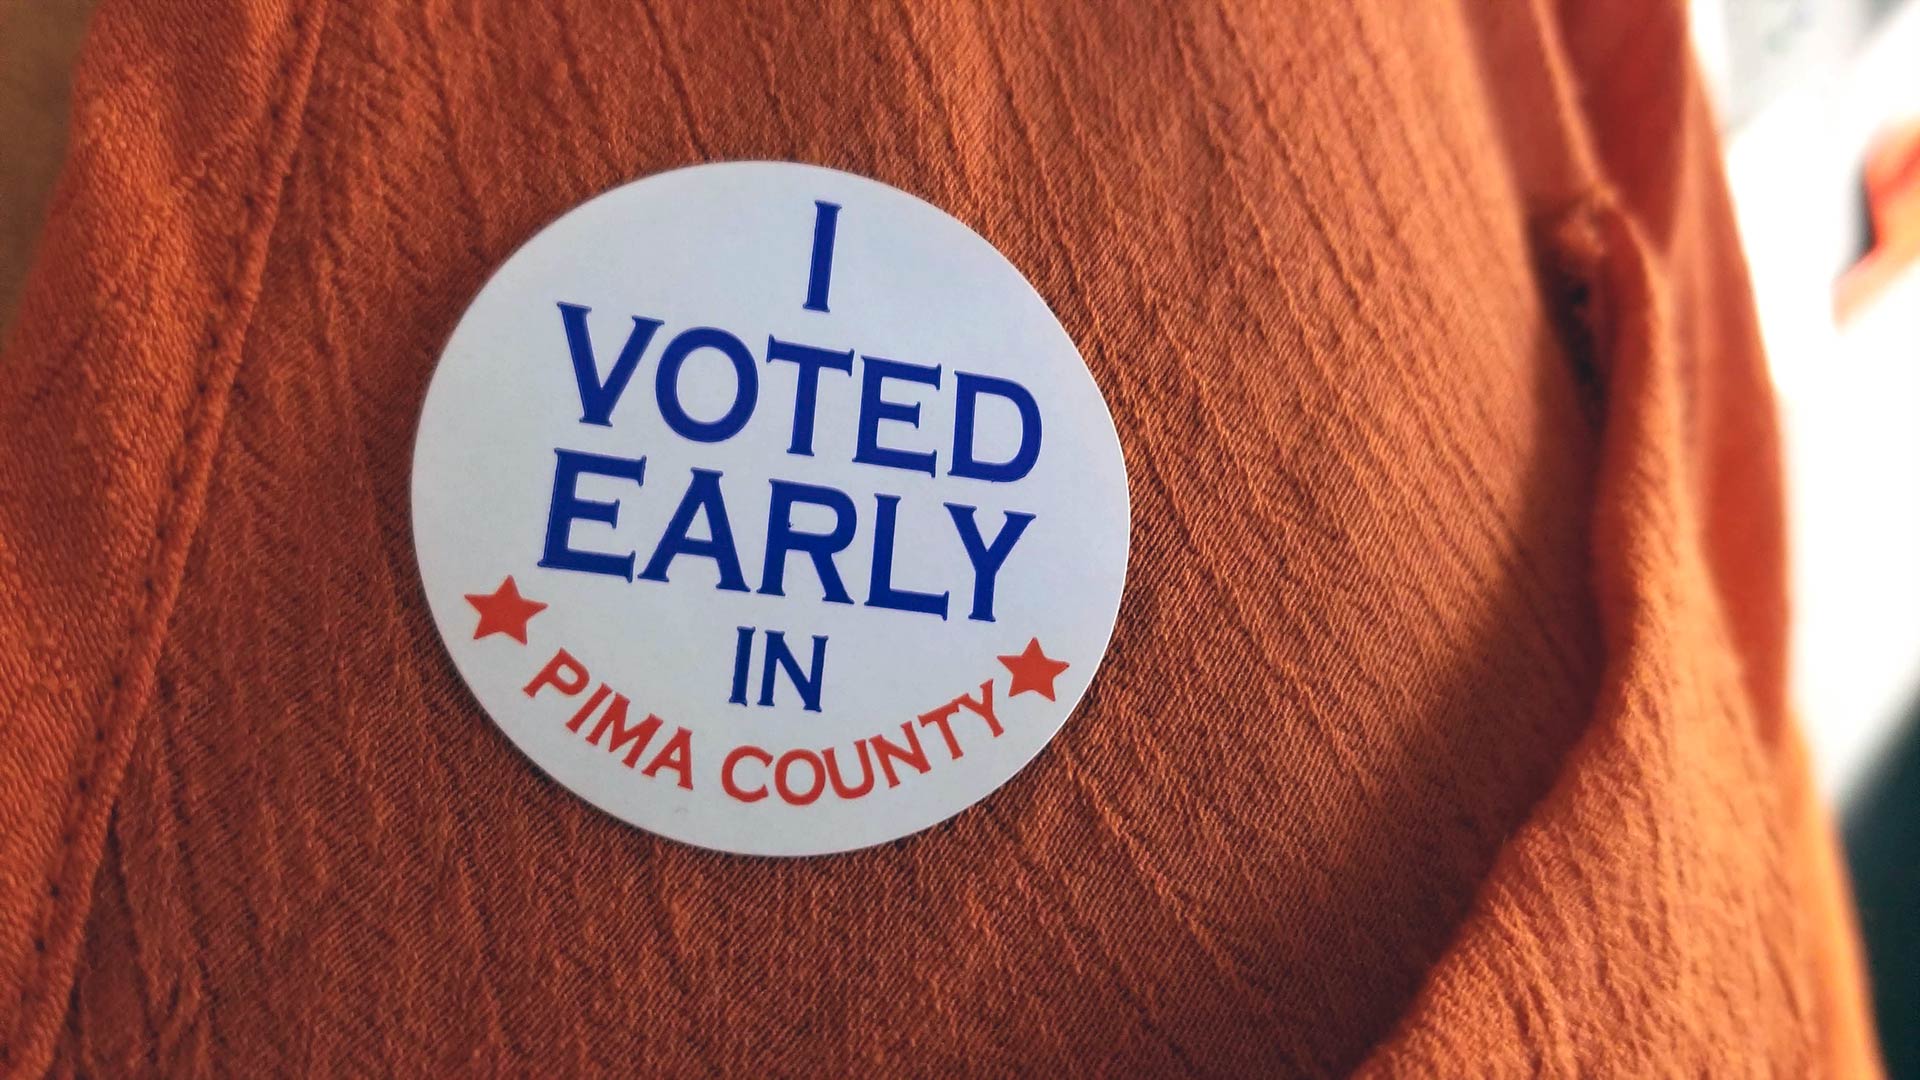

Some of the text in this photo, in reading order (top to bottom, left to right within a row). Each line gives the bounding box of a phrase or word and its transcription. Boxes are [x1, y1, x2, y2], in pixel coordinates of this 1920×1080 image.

[803, 201, 841, 313] I
[557, 303, 1043, 483] VOTED
[537, 448, 1036, 623] EARLY
[522, 647, 1004, 807] PIMA COUNTY
[729, 627, 829, 712] IN
